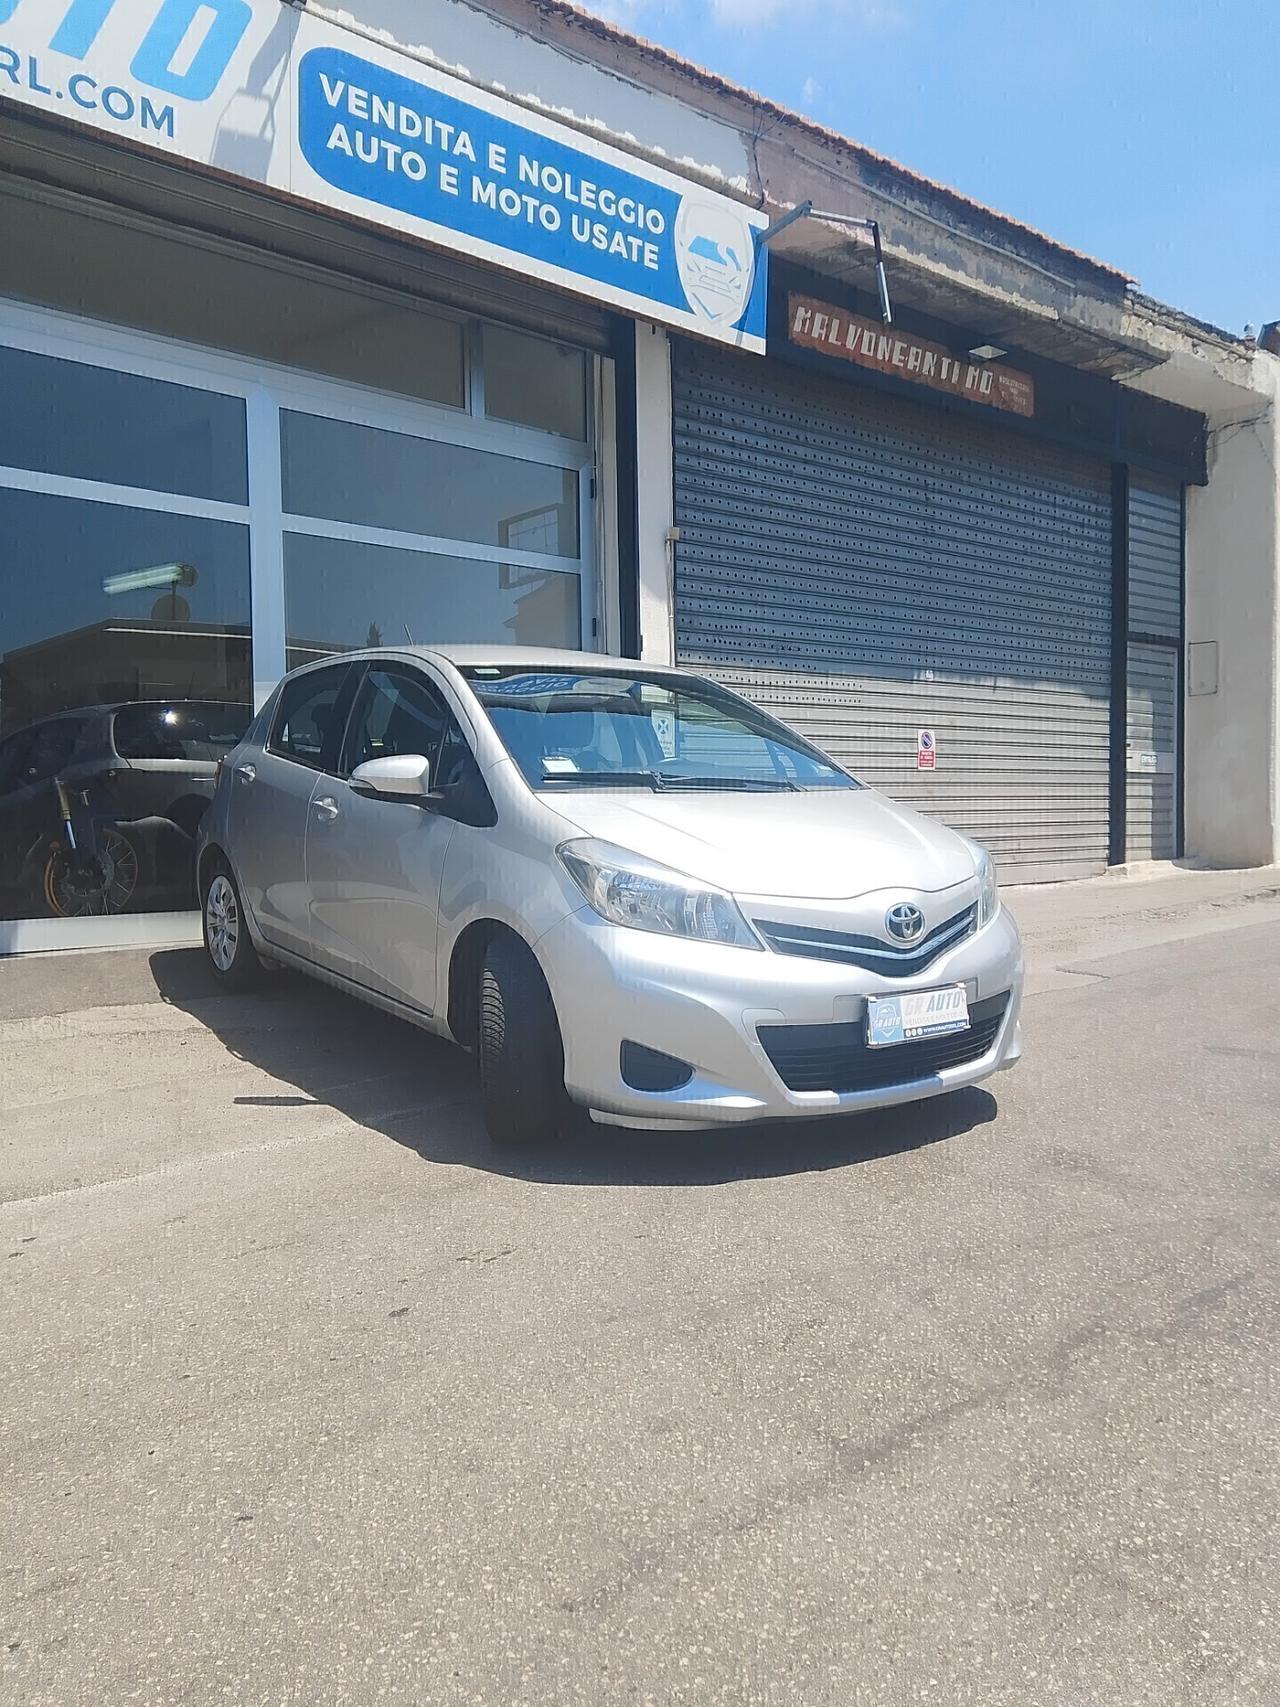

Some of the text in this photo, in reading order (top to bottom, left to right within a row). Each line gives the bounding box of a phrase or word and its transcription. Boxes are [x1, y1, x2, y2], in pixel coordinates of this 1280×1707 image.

[319, 72, 665, 235] VENDITA E NOLEGGIO
[326, 122, 659, 271] AUTO E MOTO USATE
[926, 990, 962, 1013] AUTO
